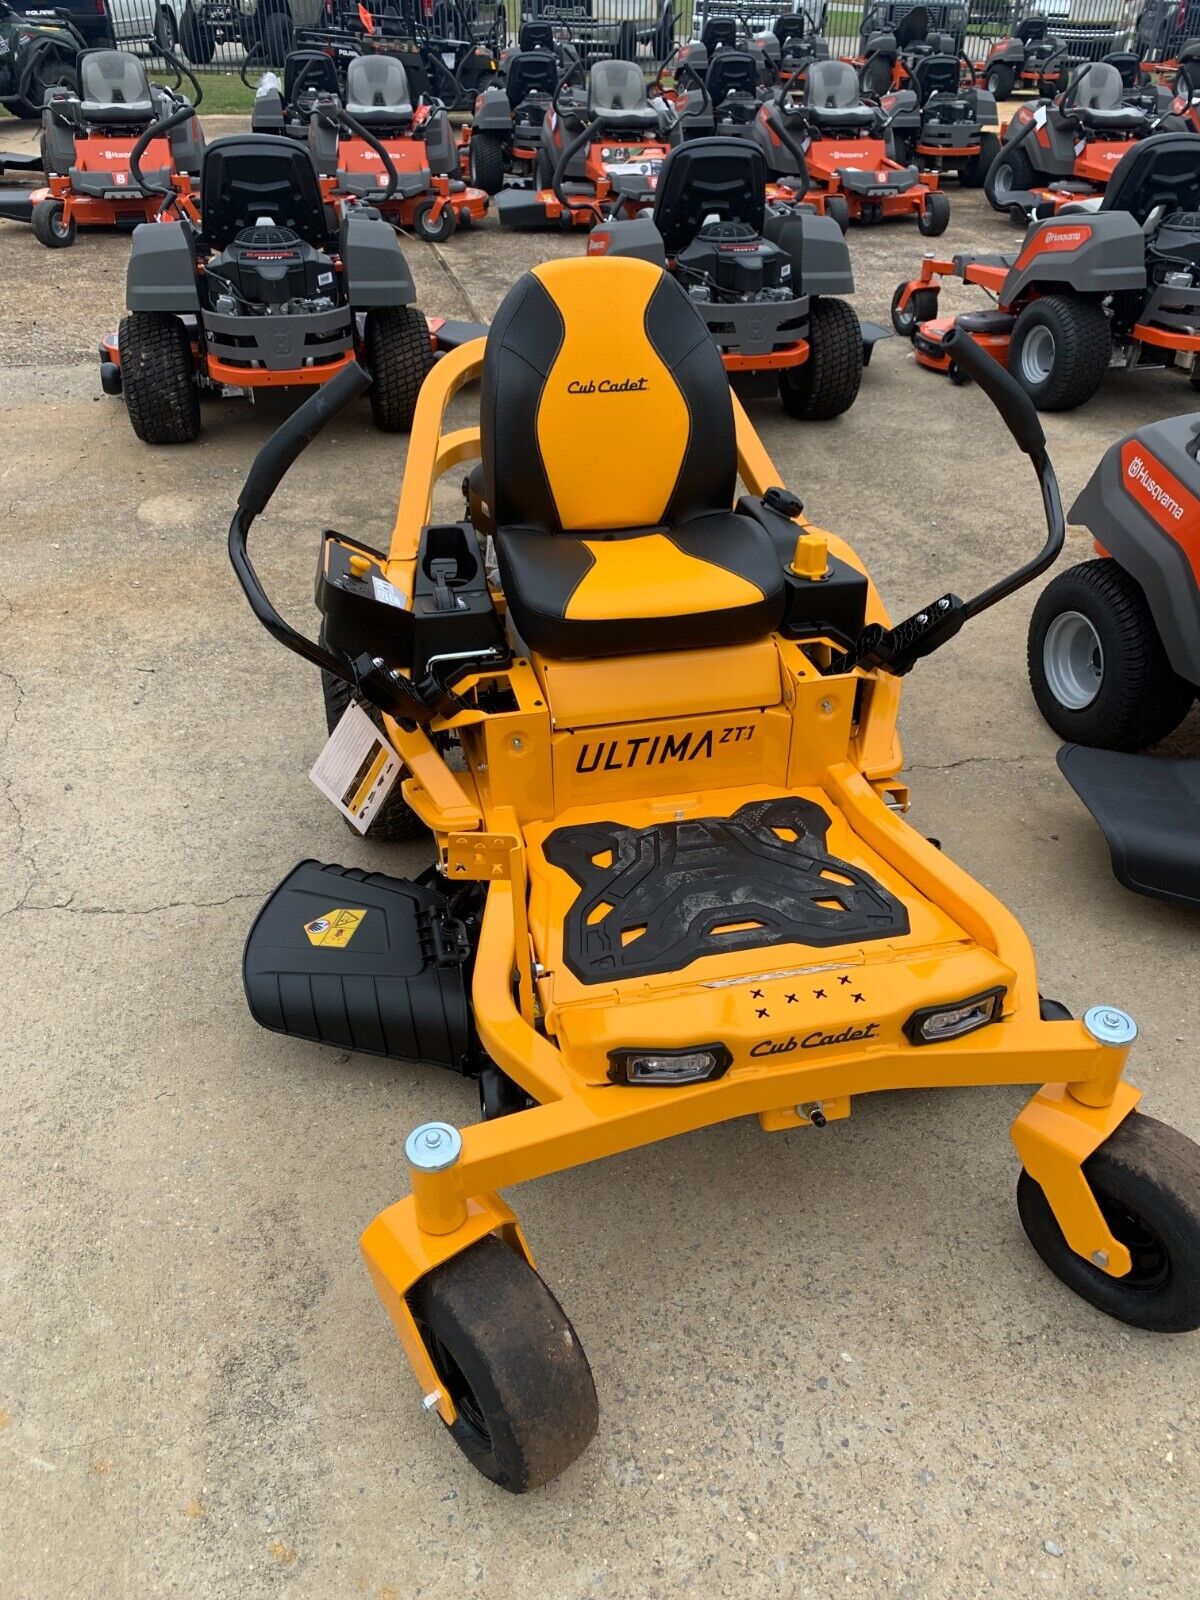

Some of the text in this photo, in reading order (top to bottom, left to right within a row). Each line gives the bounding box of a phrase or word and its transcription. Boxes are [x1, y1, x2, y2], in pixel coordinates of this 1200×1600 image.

[567, 377, 648, 394] Cub Cadet
[1136, 466, 1184, 521] Husqvarna
[575, 724, 756, 774] ULTIMA ZT1
[749, 1023, 880, 1057] Cub Cadet
